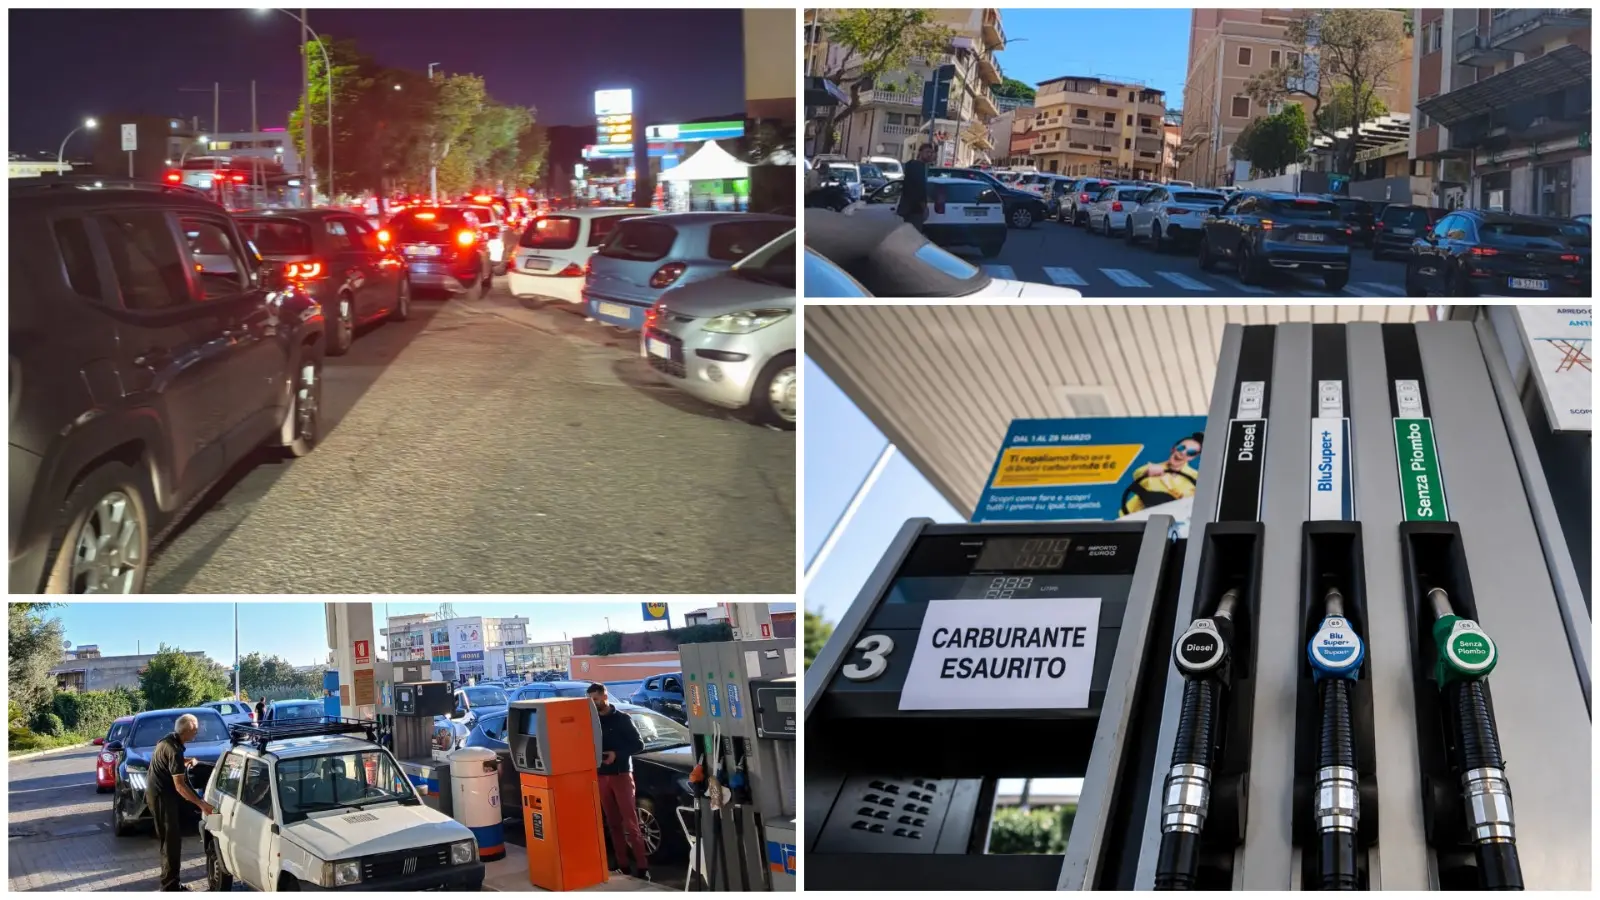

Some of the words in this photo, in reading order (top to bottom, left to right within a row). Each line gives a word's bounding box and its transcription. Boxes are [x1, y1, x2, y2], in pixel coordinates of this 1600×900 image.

[1238, 423, 1257, 461] Diesel
[1317, 430, 1337, 492] BluSuper+
[1407, 423, 1427, 472] Piombo
[1418, 474, 1433, 517] Senza
[931, 626, 1087, 649] CARBURANTE
[1186, 643, 1214, 652] Diesel
[1323, 639, 1350, 647] Super+
[843, 634, 894, 681] 3
[939, 656, 1067, 680] ESAURITO
